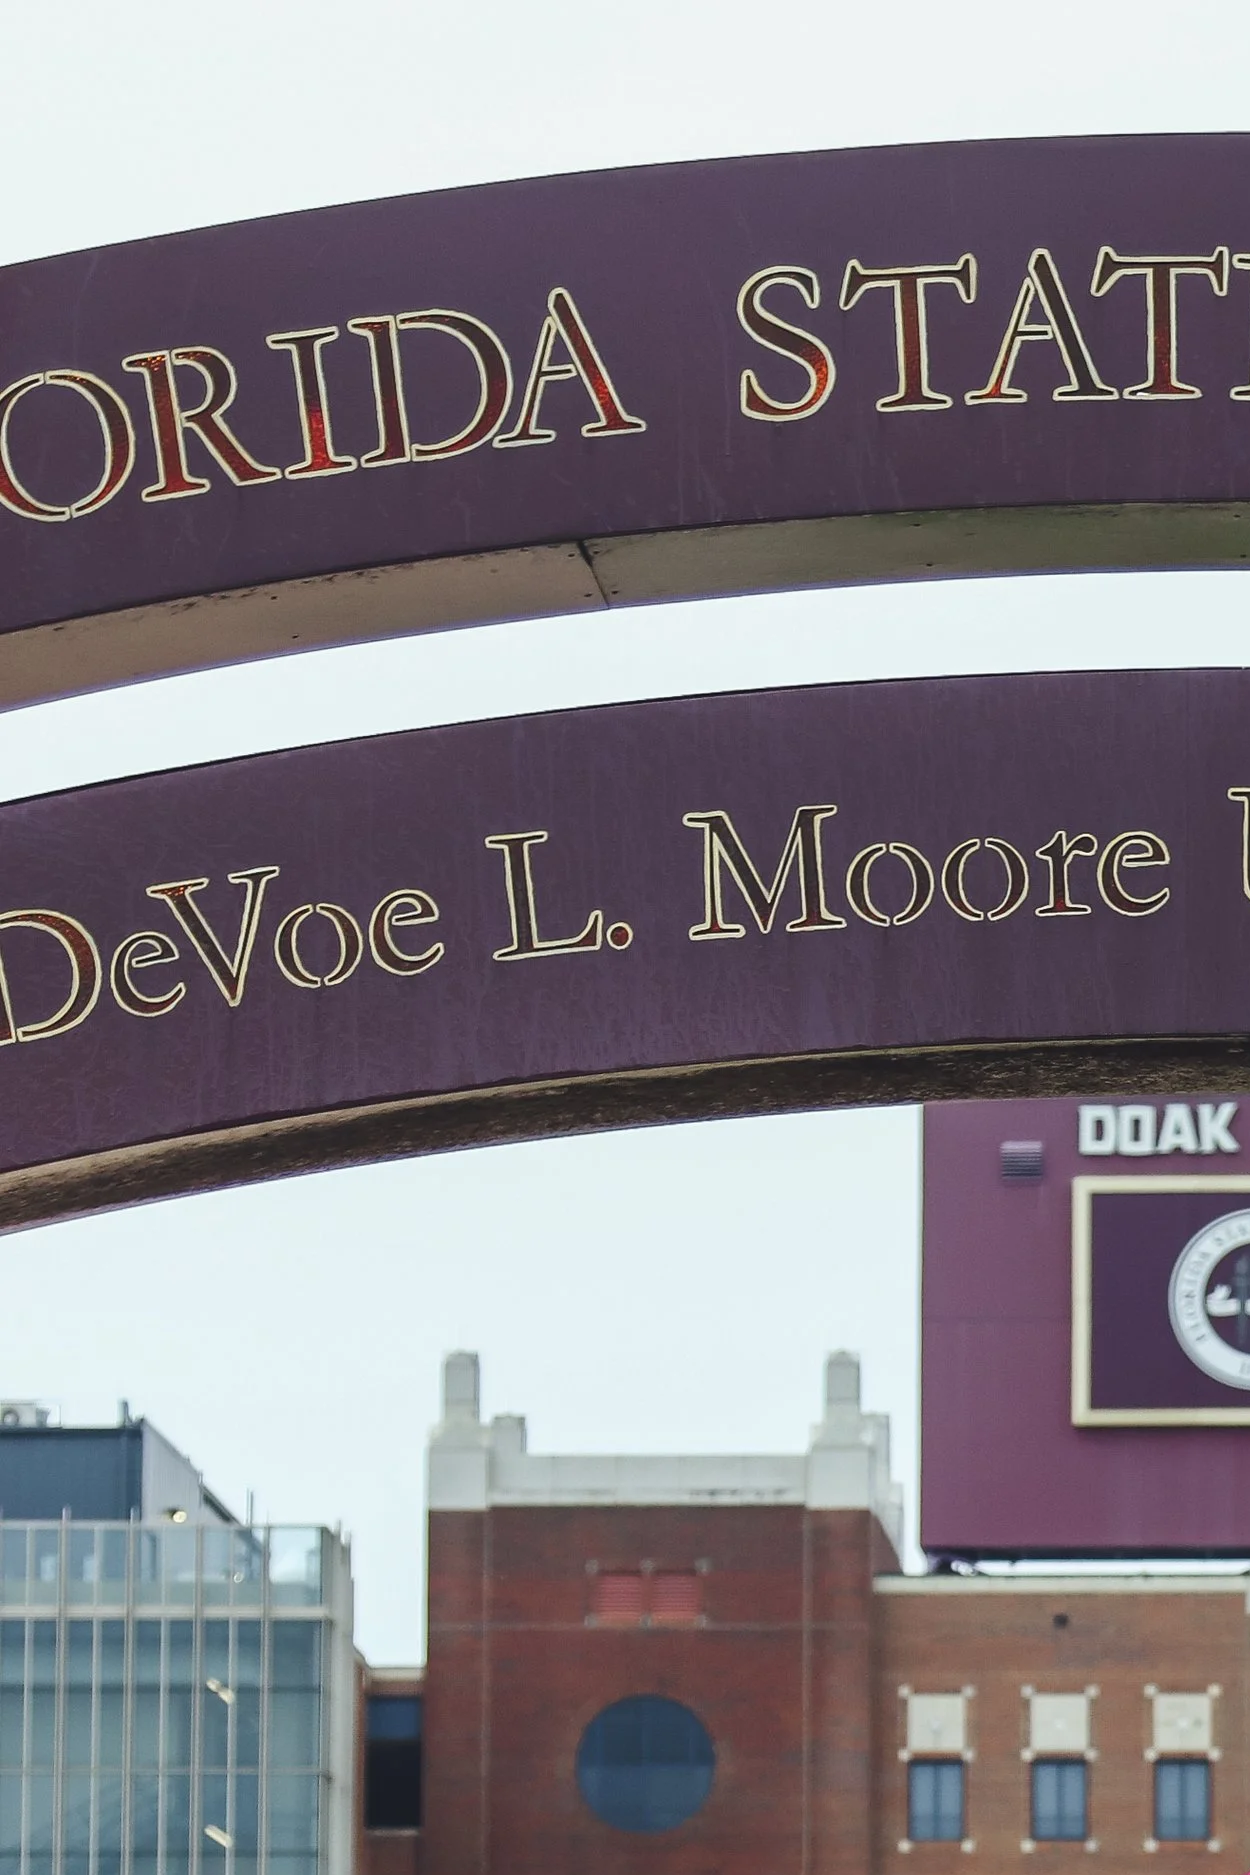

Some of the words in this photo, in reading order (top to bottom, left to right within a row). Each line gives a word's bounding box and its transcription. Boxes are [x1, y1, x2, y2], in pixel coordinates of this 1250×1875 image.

[0, 287, 646, 521] ORIDA
[0, 866, 445, 1046] DeVoe
[485, 831, 634, 961] L.
[683, 805, 1171, 941] Moore
[1078, 1102, 1239, 1155] DOAK
